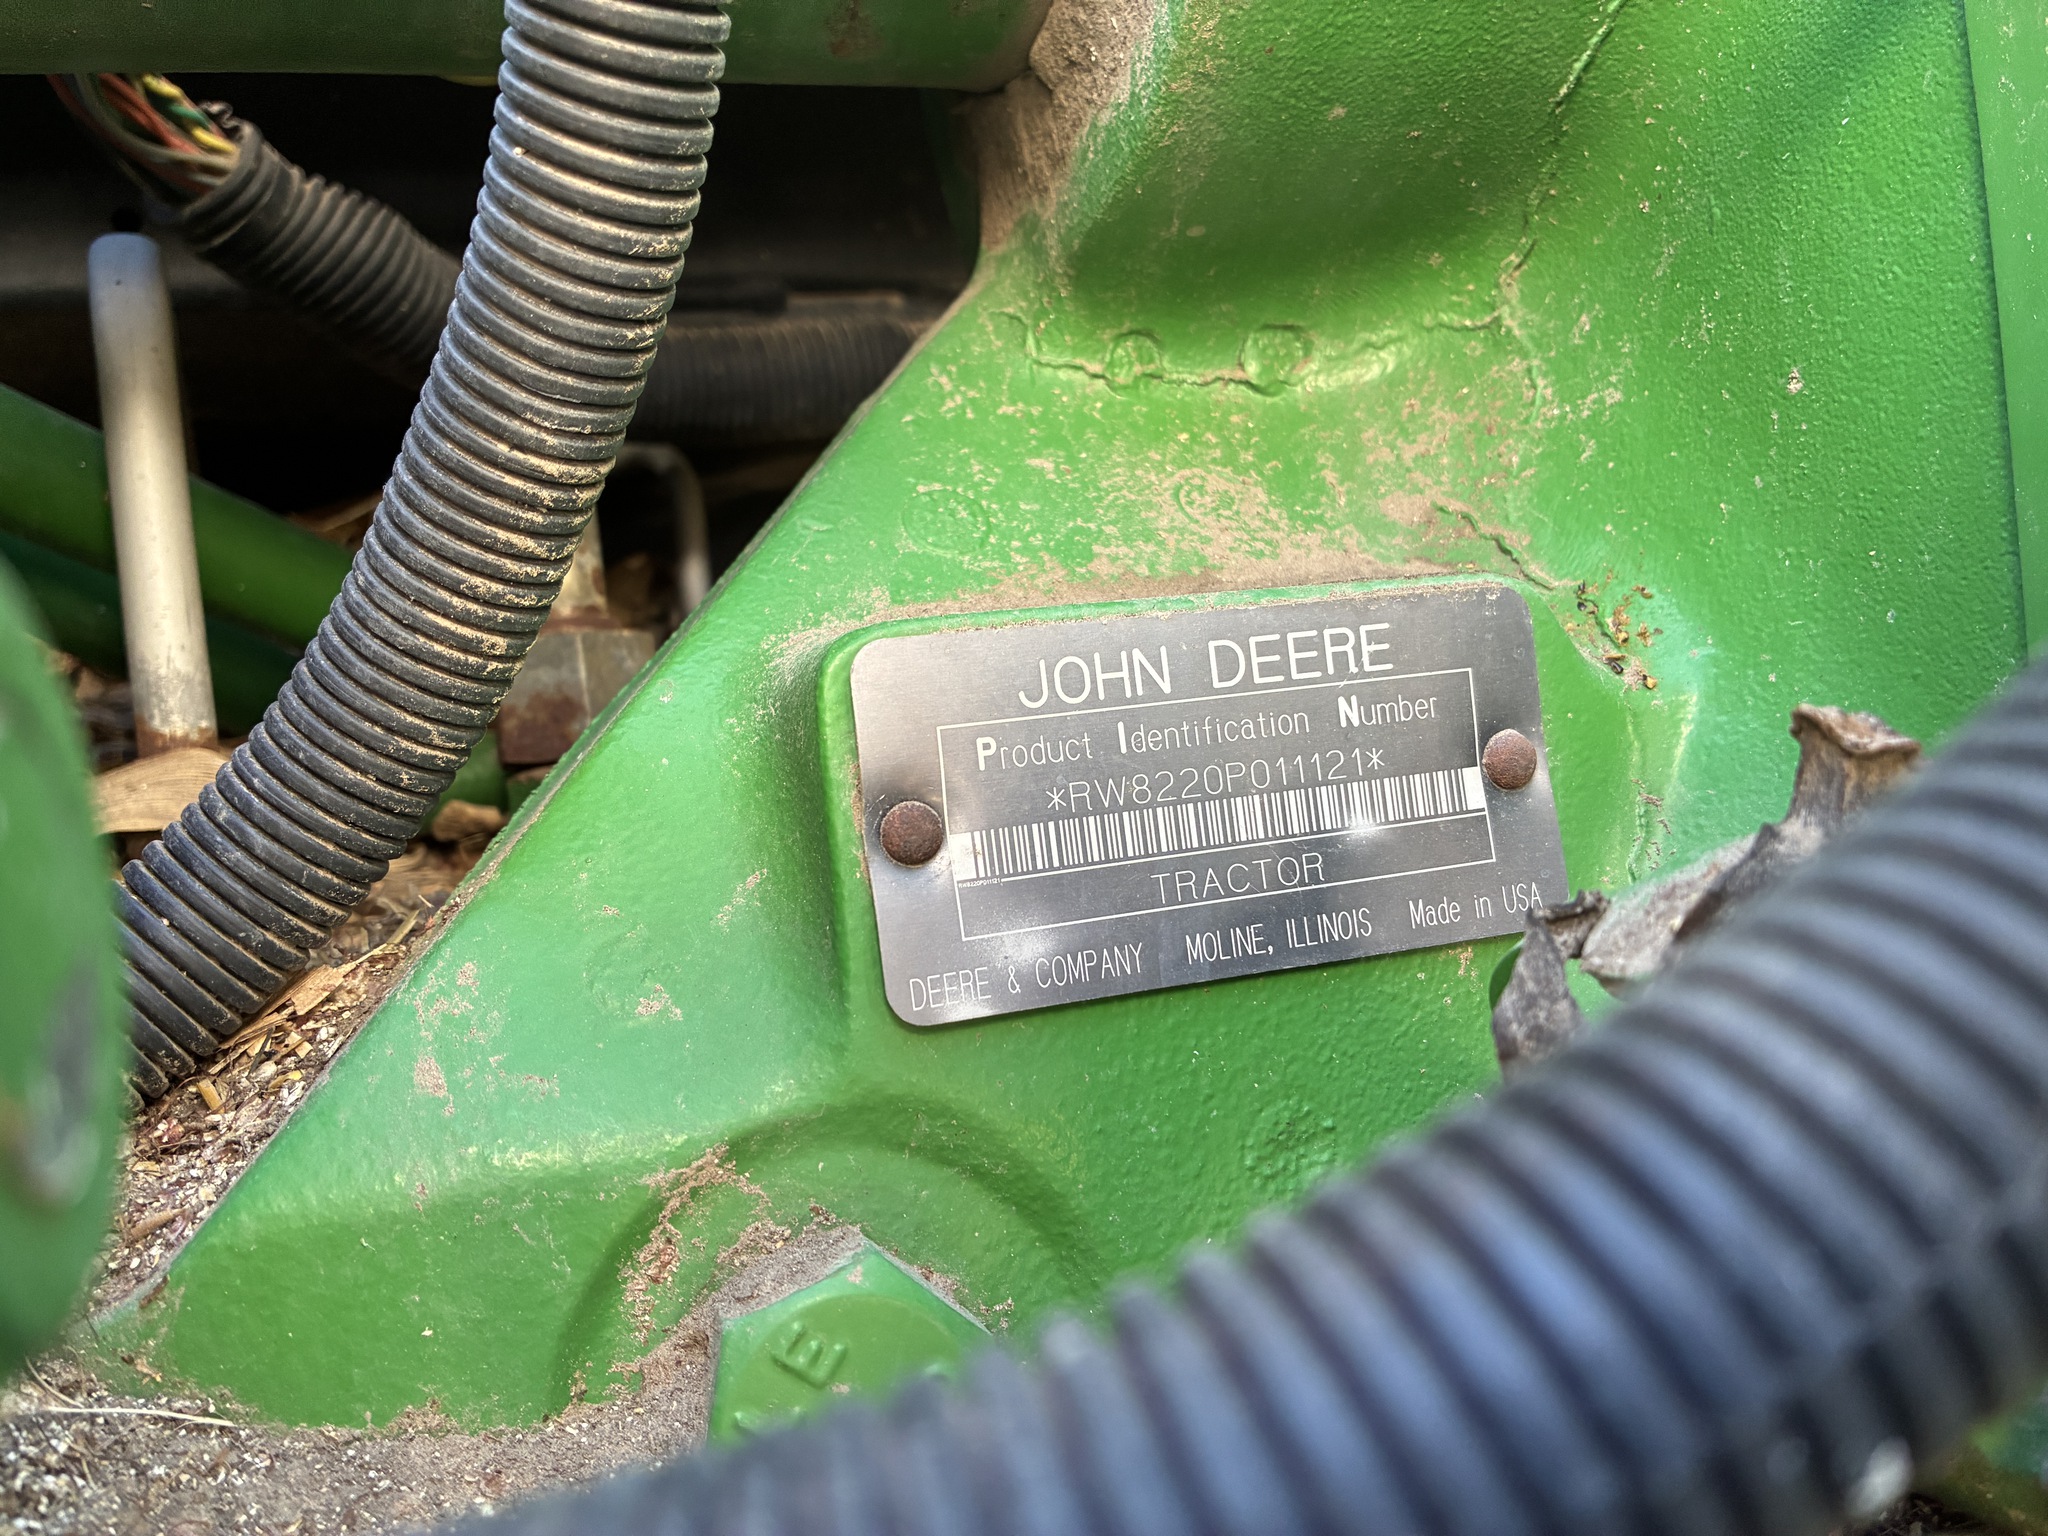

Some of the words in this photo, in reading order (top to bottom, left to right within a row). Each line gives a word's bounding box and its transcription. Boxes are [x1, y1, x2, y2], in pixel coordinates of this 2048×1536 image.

[1018, 645, 1172, 709] JOHN
[1207, 622, 1394, 689] DEERE
[975, 732, 1094, 771] Product
[1117, 711, 1310, 754] Identification
[1337, 693, 1437, 728] Number
[1150, 852, 1325, 905] TRACTOR
[909, 966, 992, 1012] DEERE
[1007, 965, 1022, 994] &
[1035, 942, 1143, 988] COMPANY
[1185, 923, 1275, 965] MOLINE,
[1285, 907, 1373, 949] ILLINOIS
[1408, 896, 1461, 929] Made
[1473, 895, 1493, 919] in
[1502, 881, 1544, 914] USA
